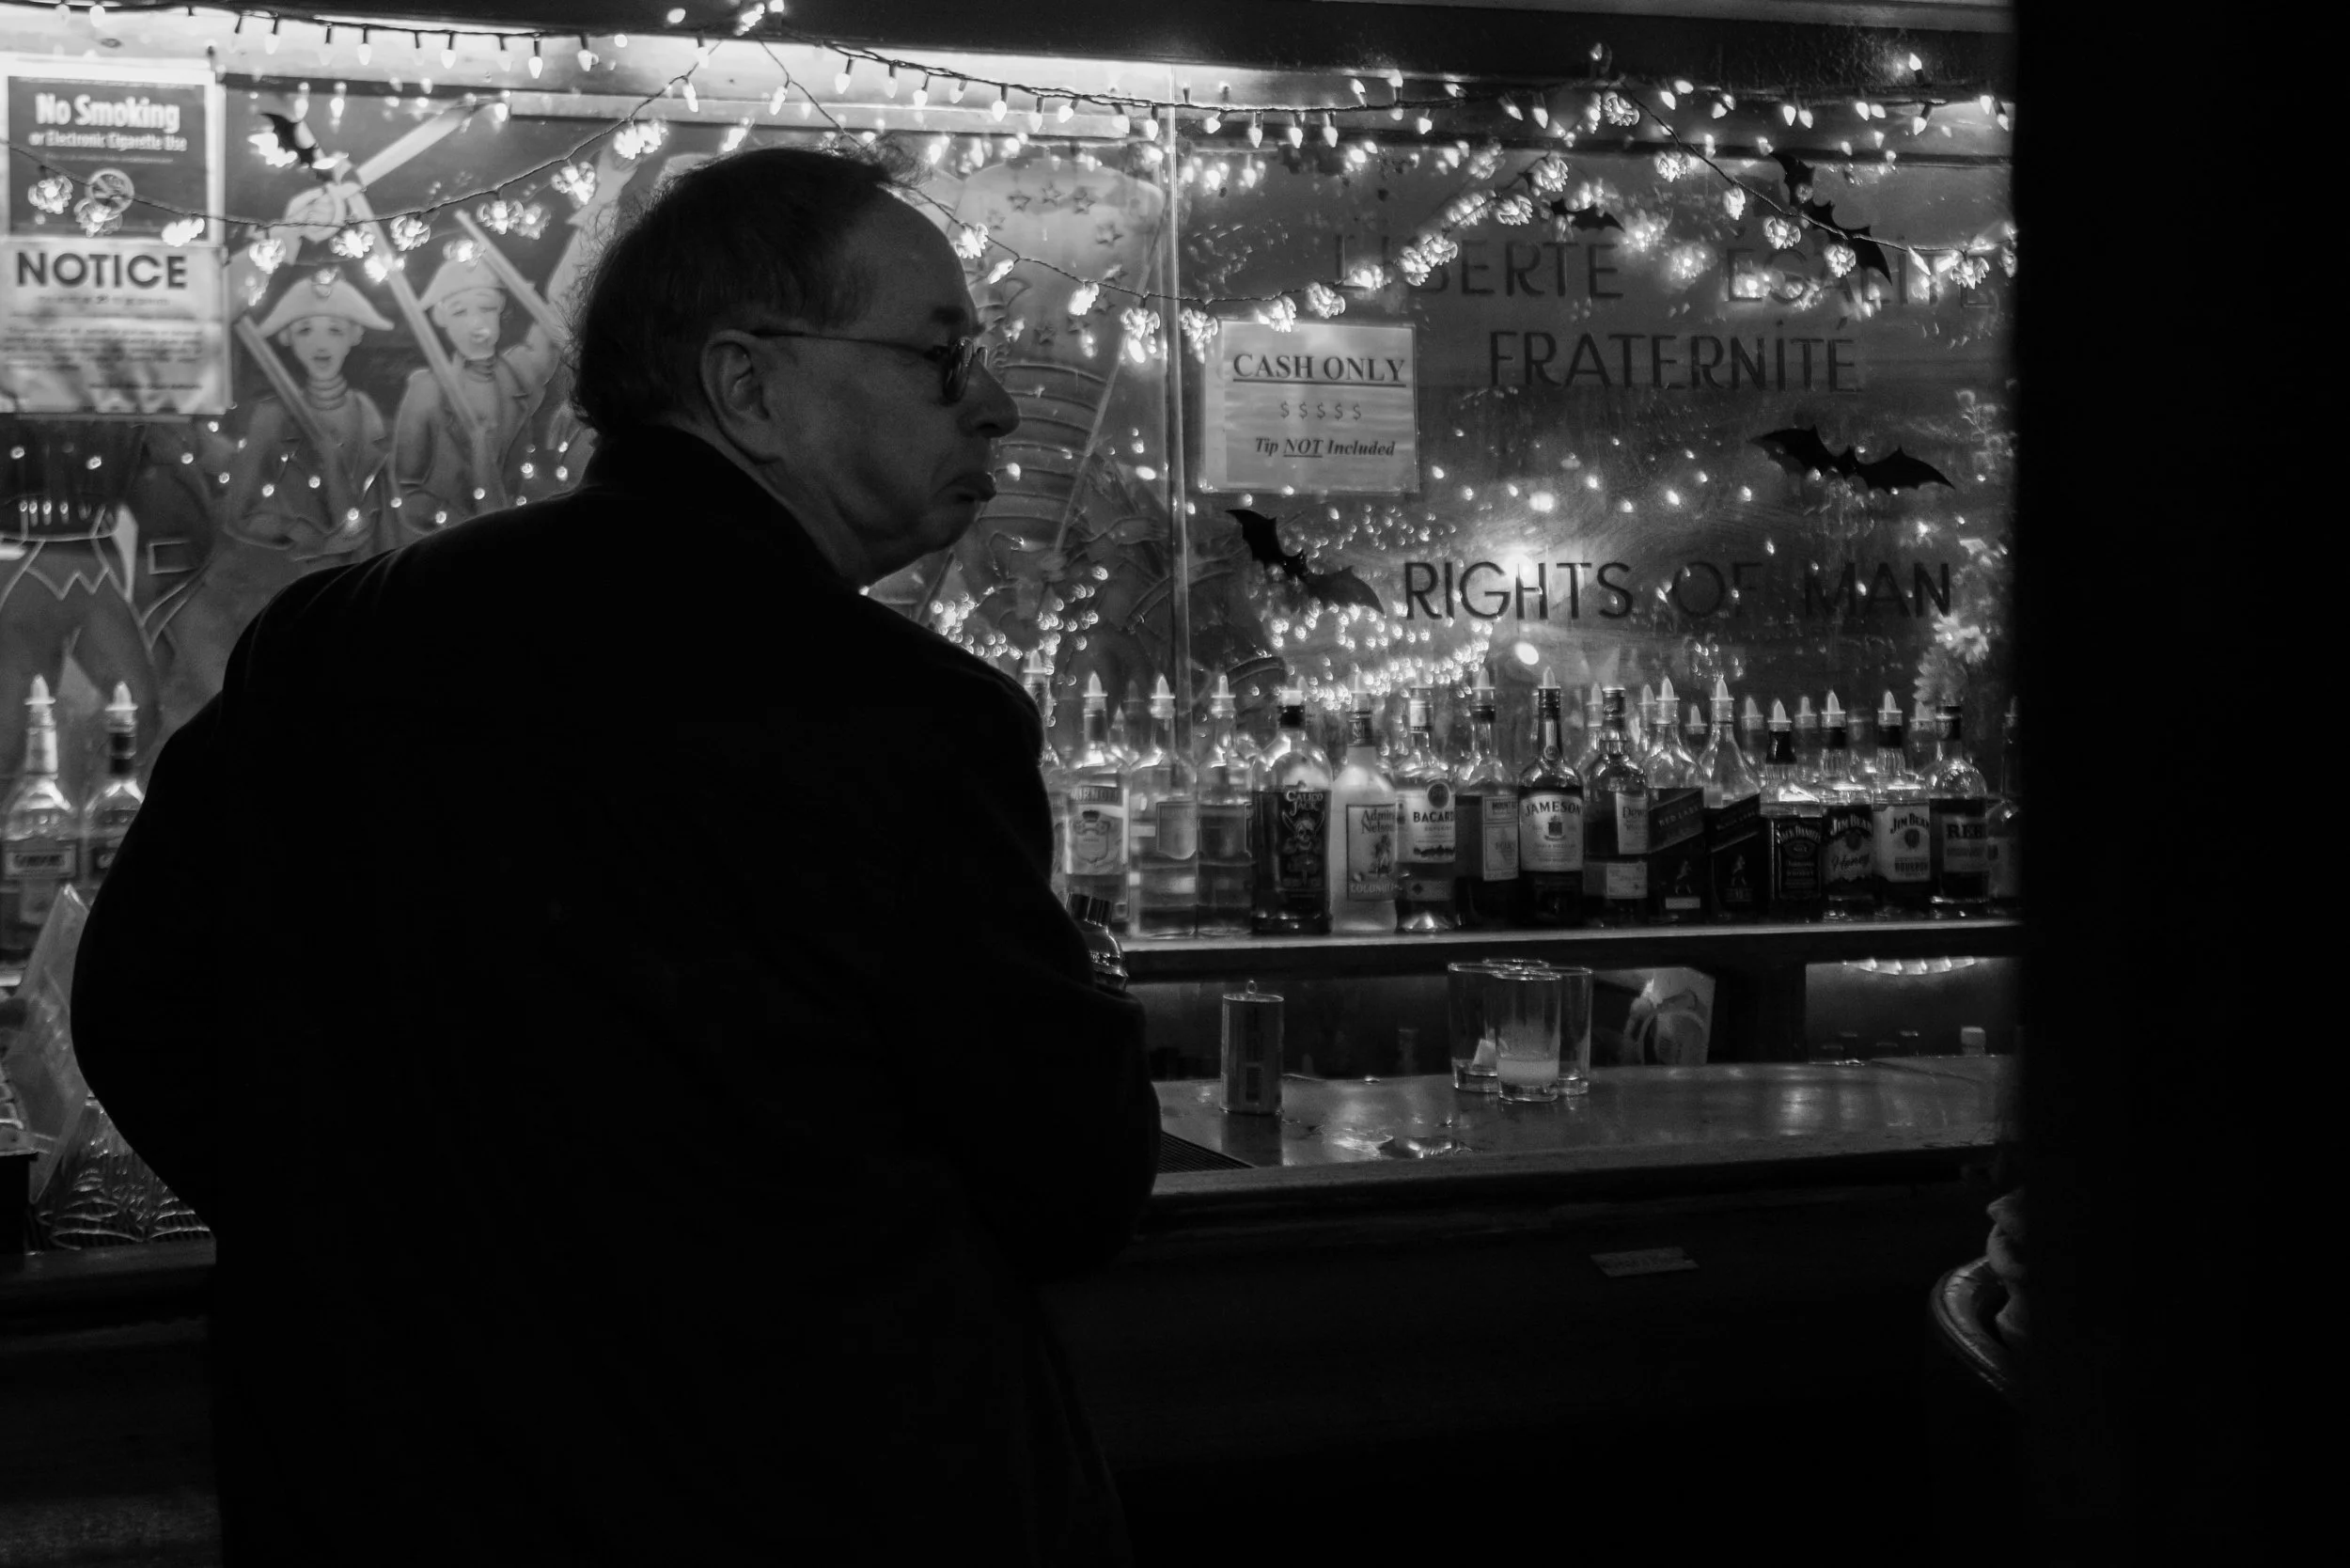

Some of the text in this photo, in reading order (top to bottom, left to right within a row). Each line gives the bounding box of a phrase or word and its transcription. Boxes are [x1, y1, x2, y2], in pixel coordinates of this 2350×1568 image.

[35, 92, 180, 133] No Smoking
[45, 130, 105, 148] Electronic
[16, 252, 187, 289] NOTICE
[1232, 353, 1406, 383] CASH ONLY
[1256, 437, 1396, 458] Tip NOT Included
[1404, 561, 1951, 620] RIGHTS OF MAN
[1413, 811, 1455, 823] BACAR
[1525, 800, 1581, 817] JAMESON
